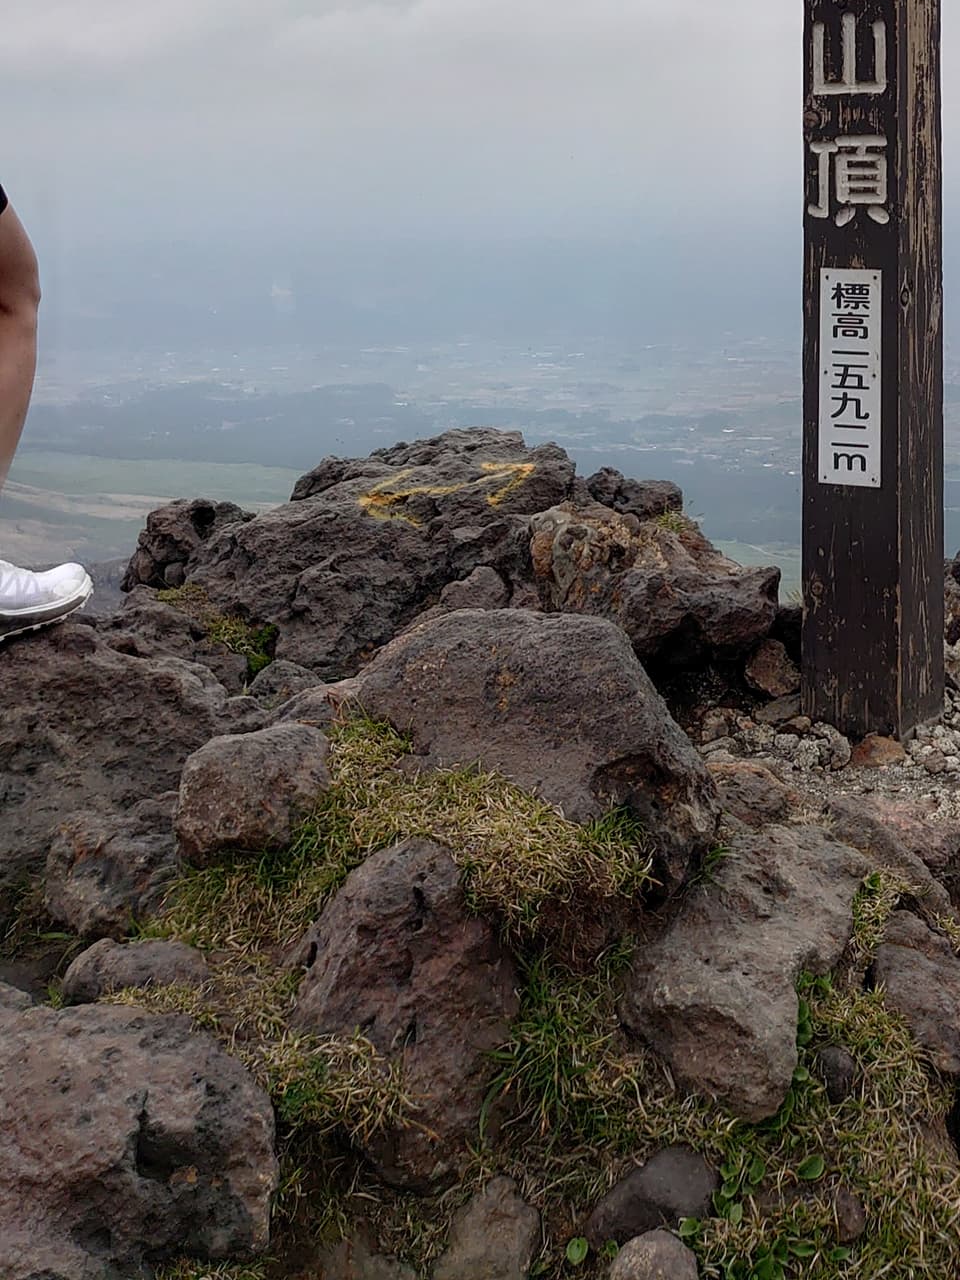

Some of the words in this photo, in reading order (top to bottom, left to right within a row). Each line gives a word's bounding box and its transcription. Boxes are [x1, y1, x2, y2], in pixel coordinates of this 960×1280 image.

[830, 282, 870, 472] 標高一五九二m
